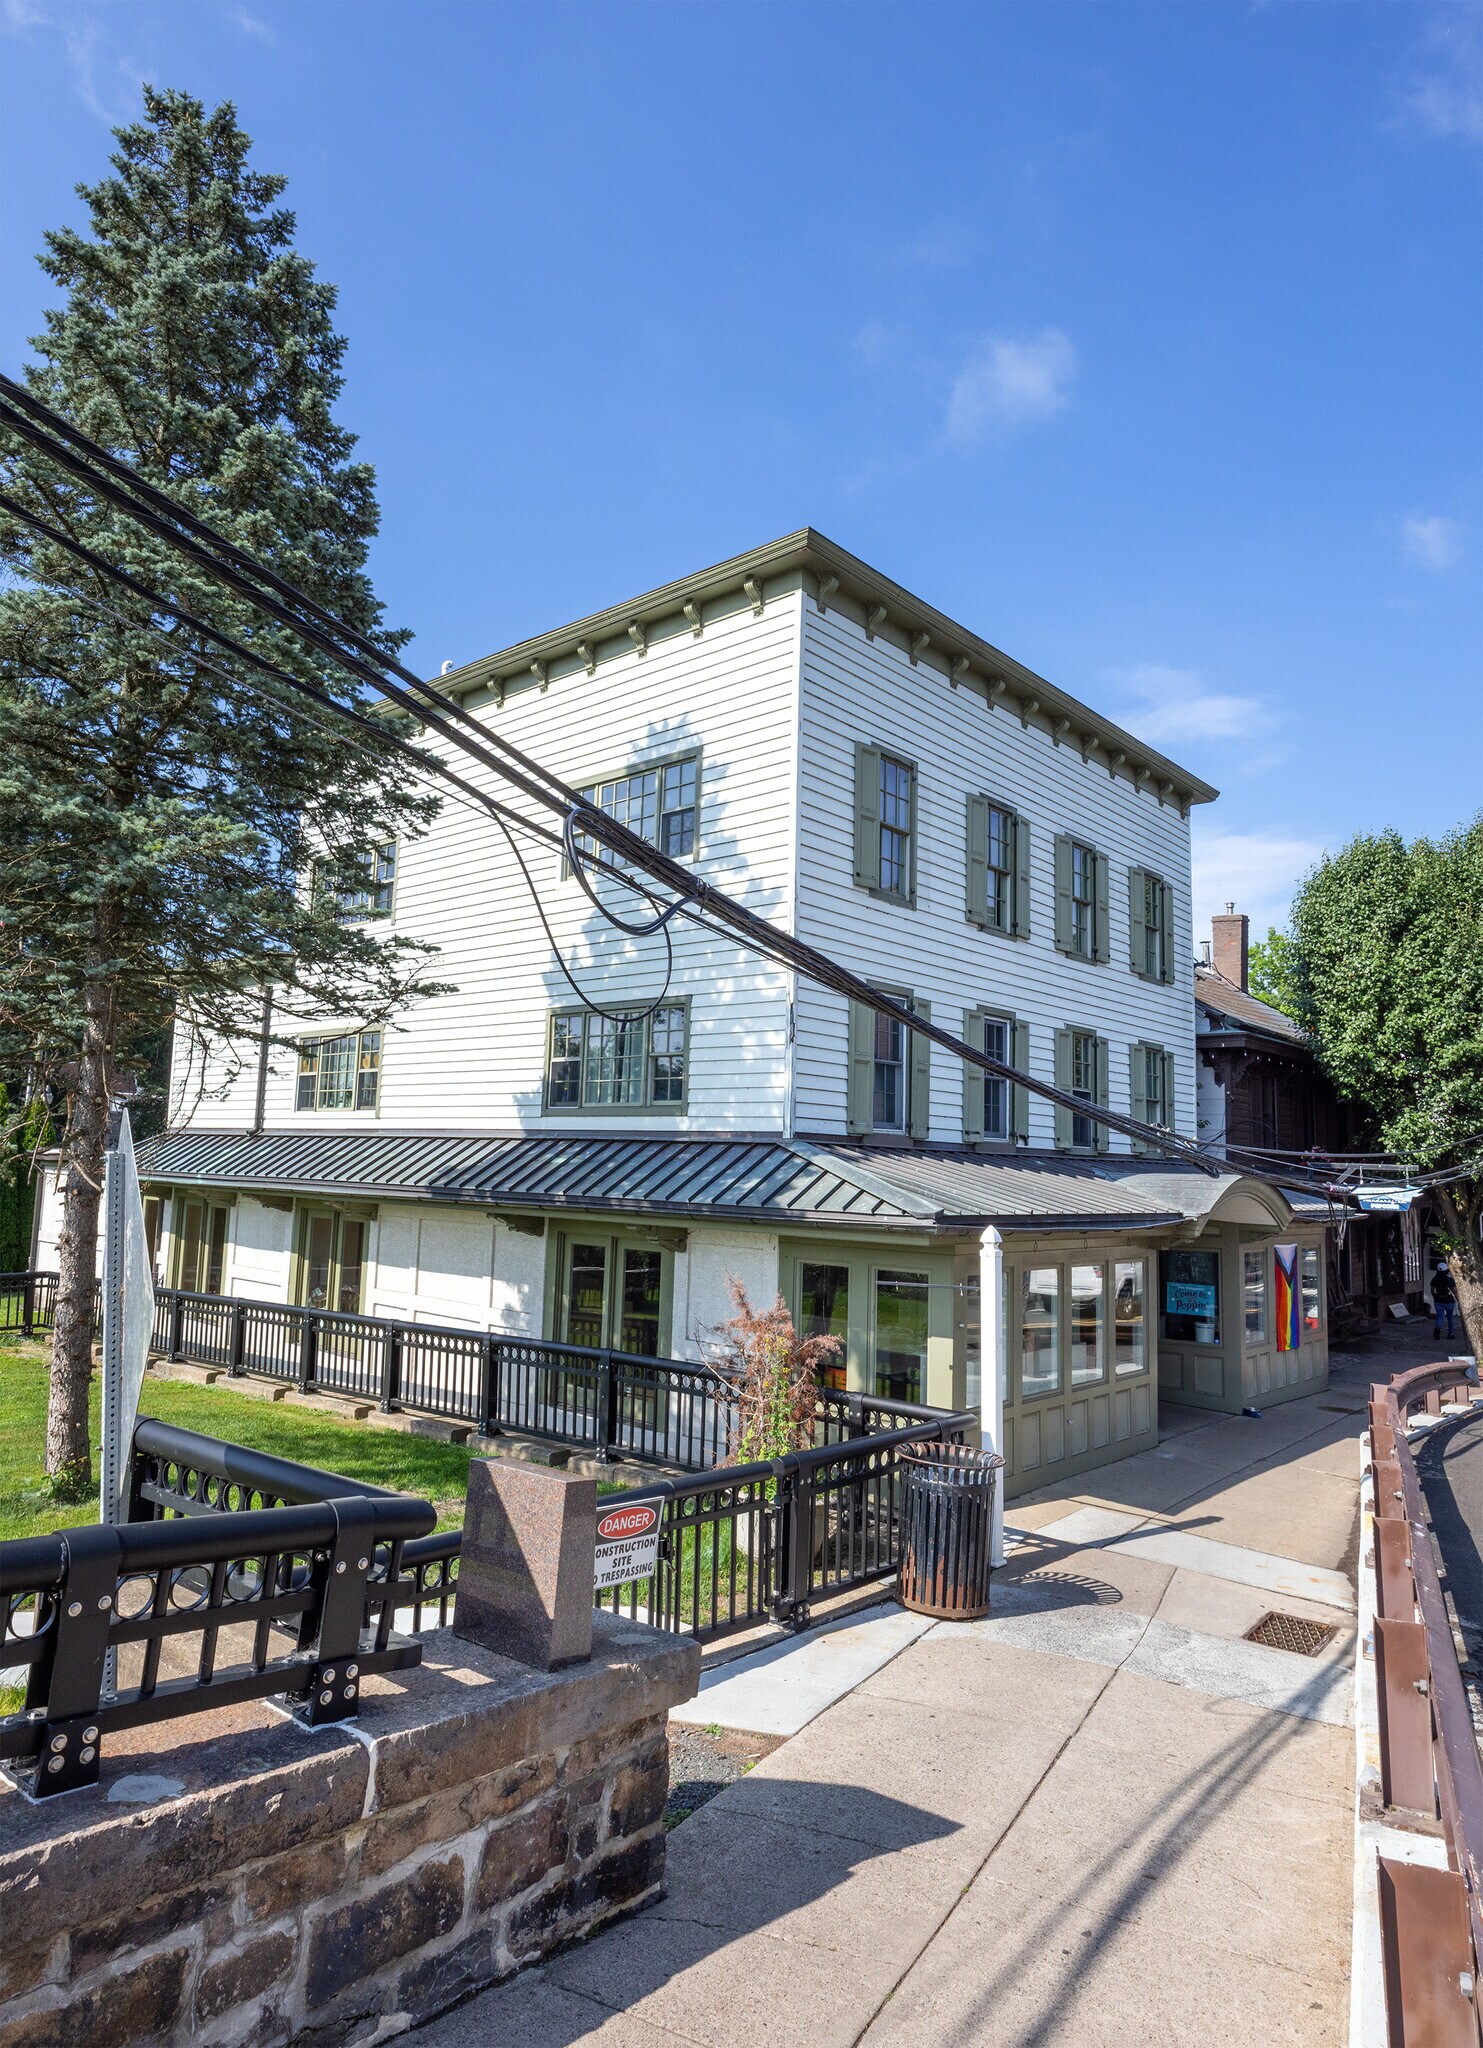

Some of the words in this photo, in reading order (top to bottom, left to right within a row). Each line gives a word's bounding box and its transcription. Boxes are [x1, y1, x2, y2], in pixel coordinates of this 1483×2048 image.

[1174, 1289, 1197, 1298] Come
[603, 1512, 650, 1533] DANGER
[595, 1537, 656, 1559] ONSTRUCTION
[612, 1554, 632, 1569] SITE
[601, 1561, 653, 1584] TRESPASSING
